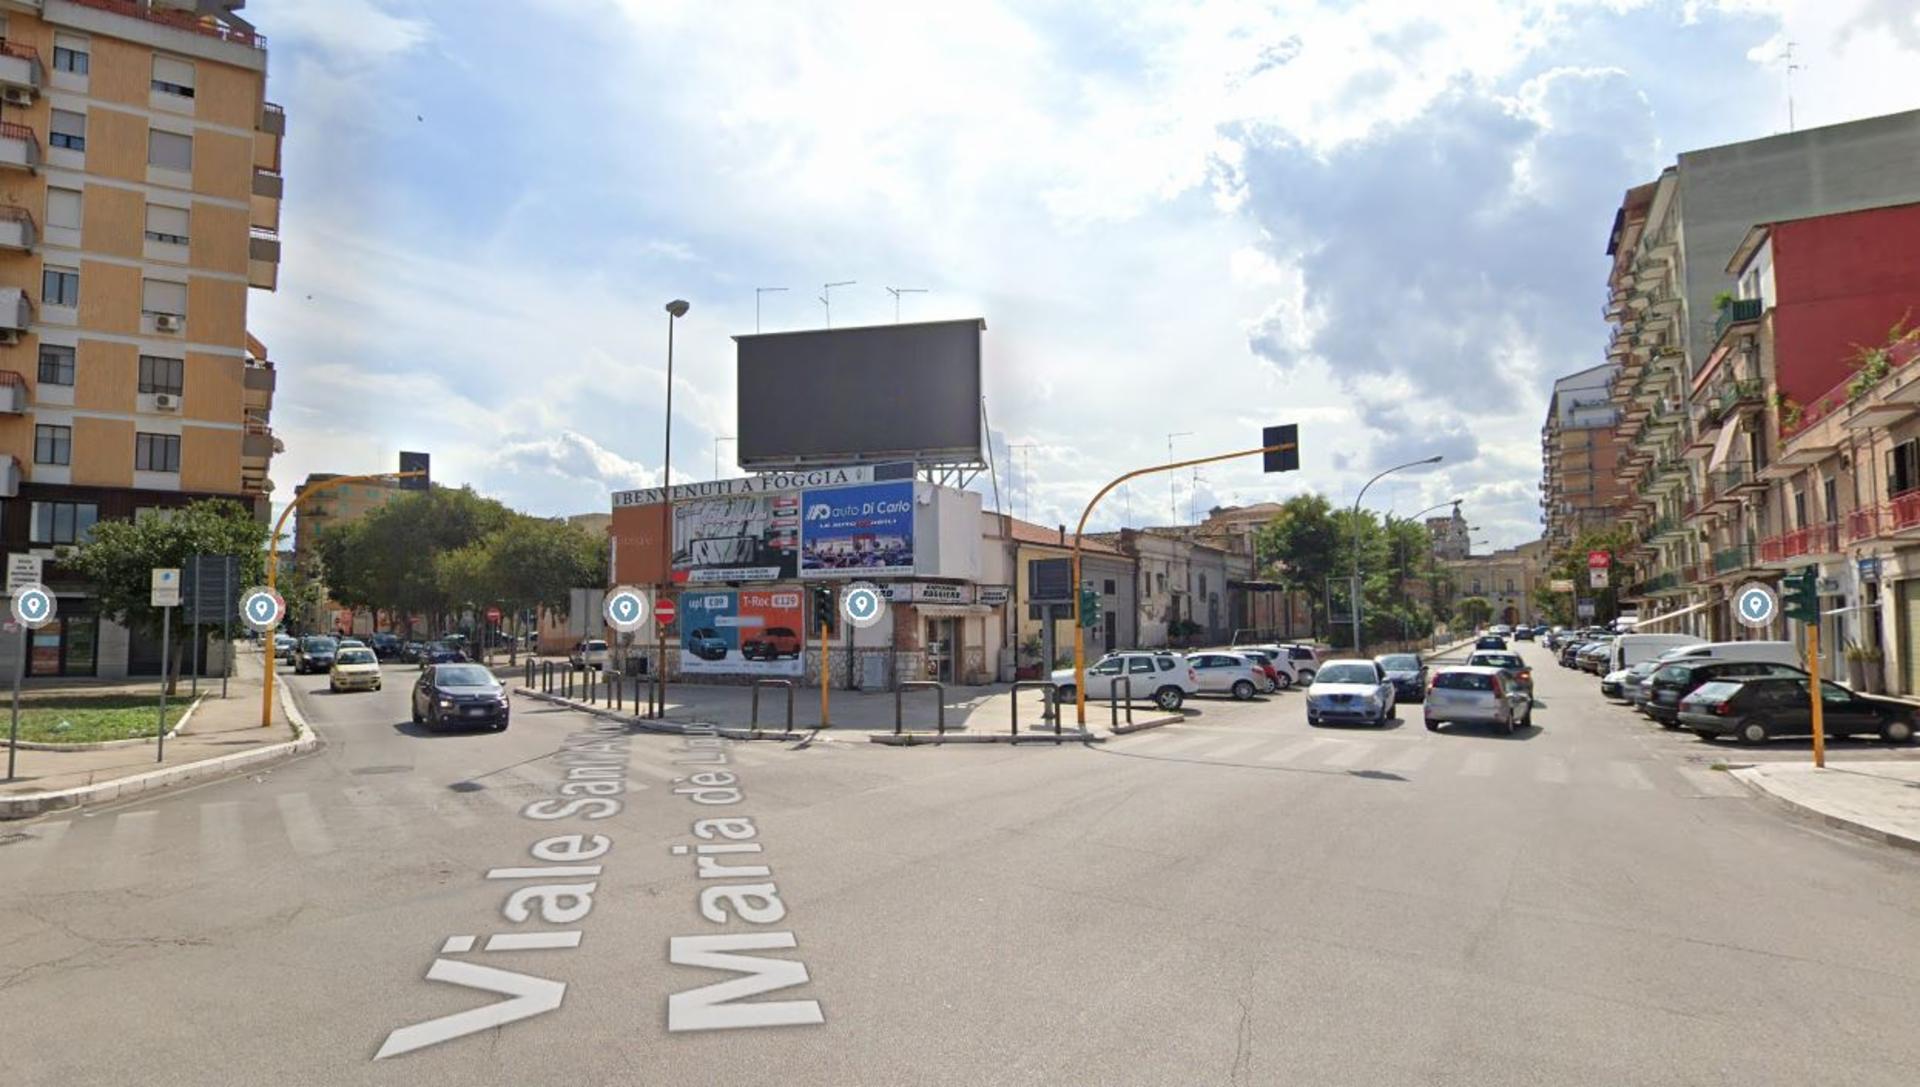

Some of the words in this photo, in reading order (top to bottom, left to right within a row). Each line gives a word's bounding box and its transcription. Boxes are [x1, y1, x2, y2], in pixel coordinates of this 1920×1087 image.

[623, 482, 732, 504] BENVENUTI
[741, 479, 753, 493] A
[763, 470, 848, 489] FOGGIA
[832, 505, 859, 518] auto
[862, 502, 874, 515] Di
[877, 500, 911, 514] Carlo
